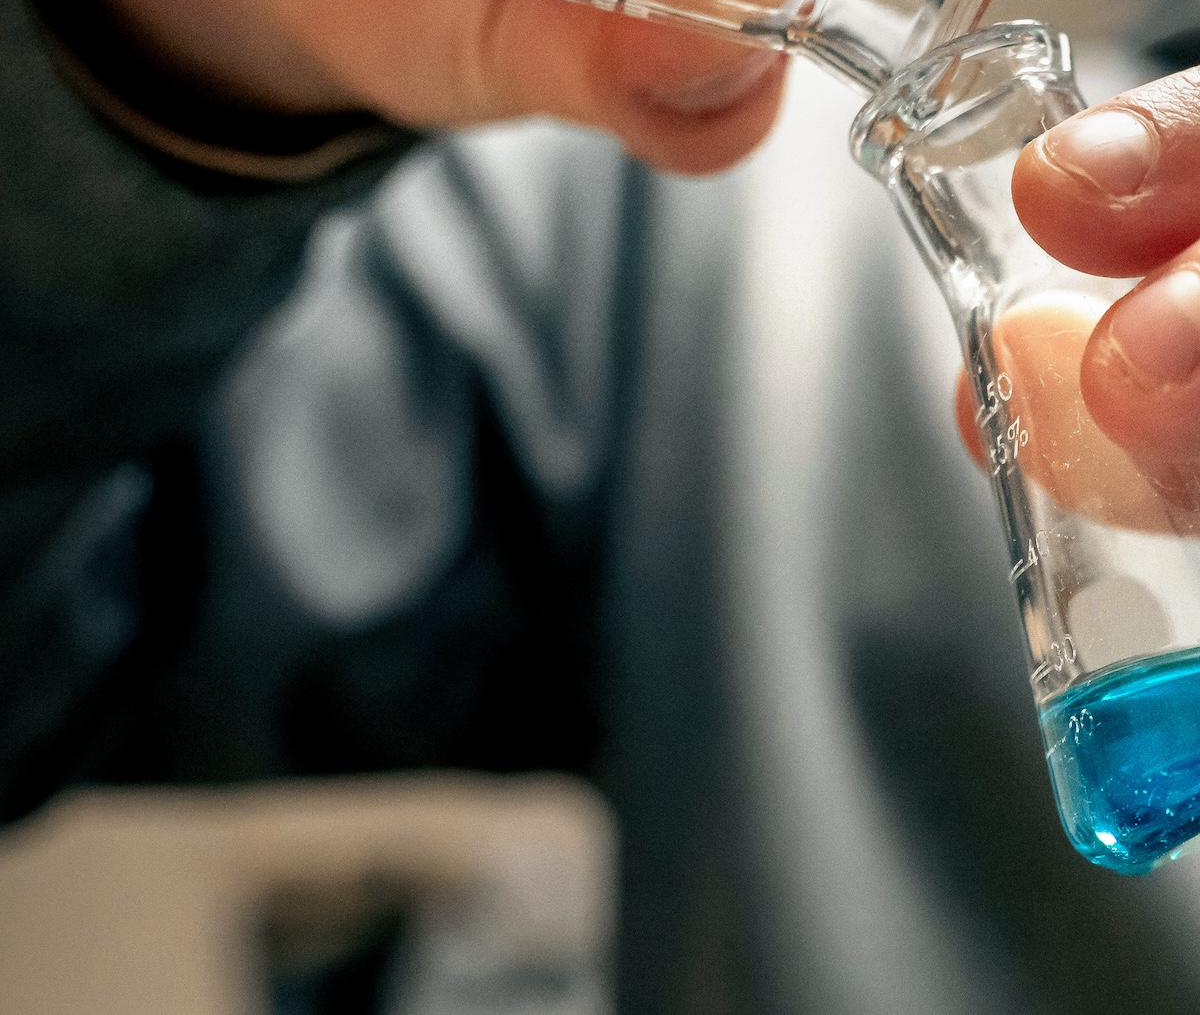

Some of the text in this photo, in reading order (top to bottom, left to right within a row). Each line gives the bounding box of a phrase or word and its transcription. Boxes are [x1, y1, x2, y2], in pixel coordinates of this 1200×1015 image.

[986, 372, 1013, 414] 50
[1028, 530, 1050, 566] 40
[1051, 634, 1076, 672] 30
